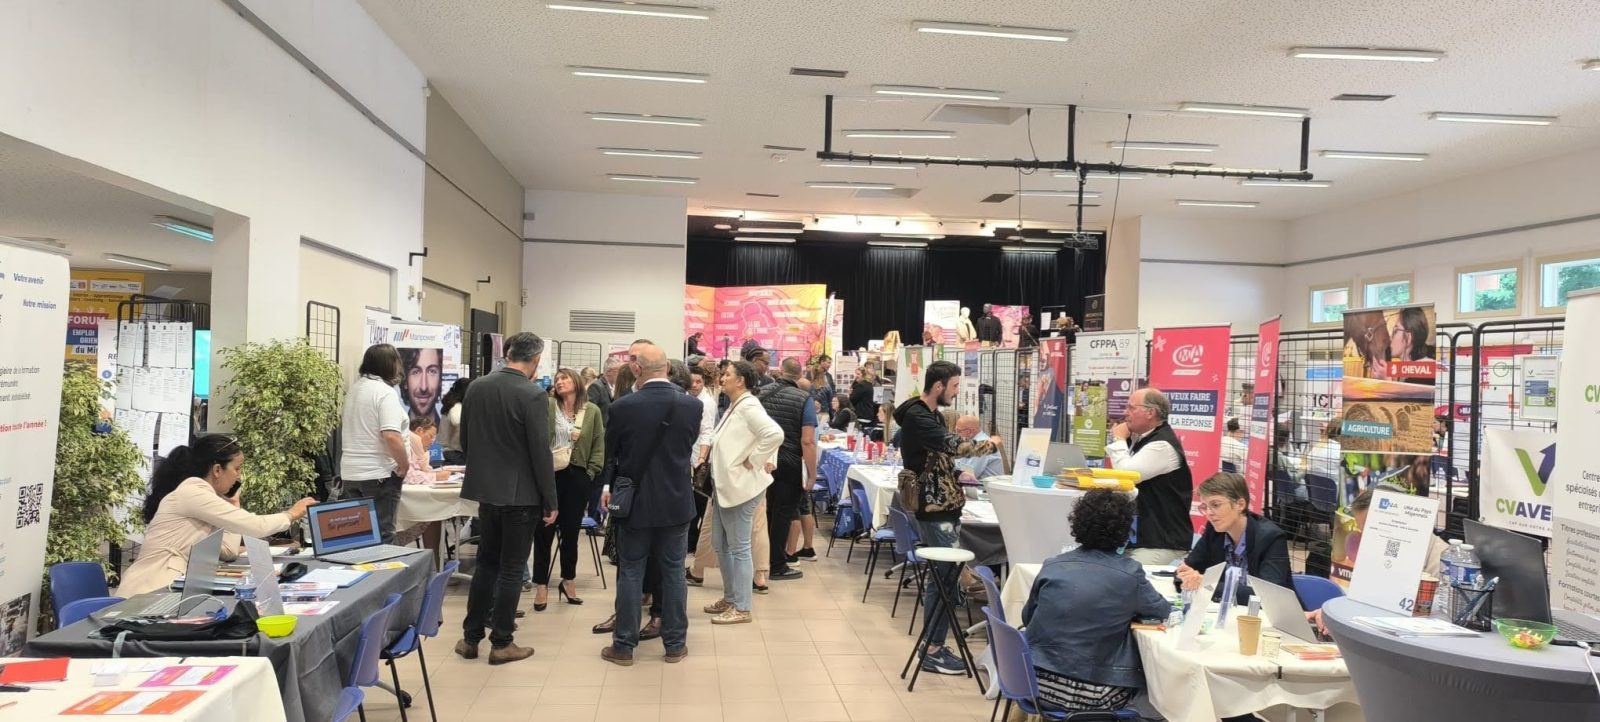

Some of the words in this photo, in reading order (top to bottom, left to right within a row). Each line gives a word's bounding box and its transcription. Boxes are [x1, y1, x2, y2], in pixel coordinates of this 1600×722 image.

[37, 301, 56, 310] mission
[75, 346, 85, 354] du
[87, 346, 98, 354] Mi
[1090, 339, 1118, 351] CFPPA
[1119, 339, 1130, 349] 89
[1401, 365, 1432, 375] CHEVAL
[1170, 392, 1189, 401] VEUX
[1190, 393, 1211, 401] FAIRE
[1172, 404, 1189, 412] PLUS
[1190, 404, 1209, 413] TARD
[23, 421, 43, 429] l'année
[1182, 417, 1213, 428] RÉPONSE
[1348, 424, 1390, 435] AGRICULTURE
[1566, 484, 1598, 498] spécialisés
[1495, 498, 1552, 521] CVAVE
[1399, 597, 1414, 612] 42
